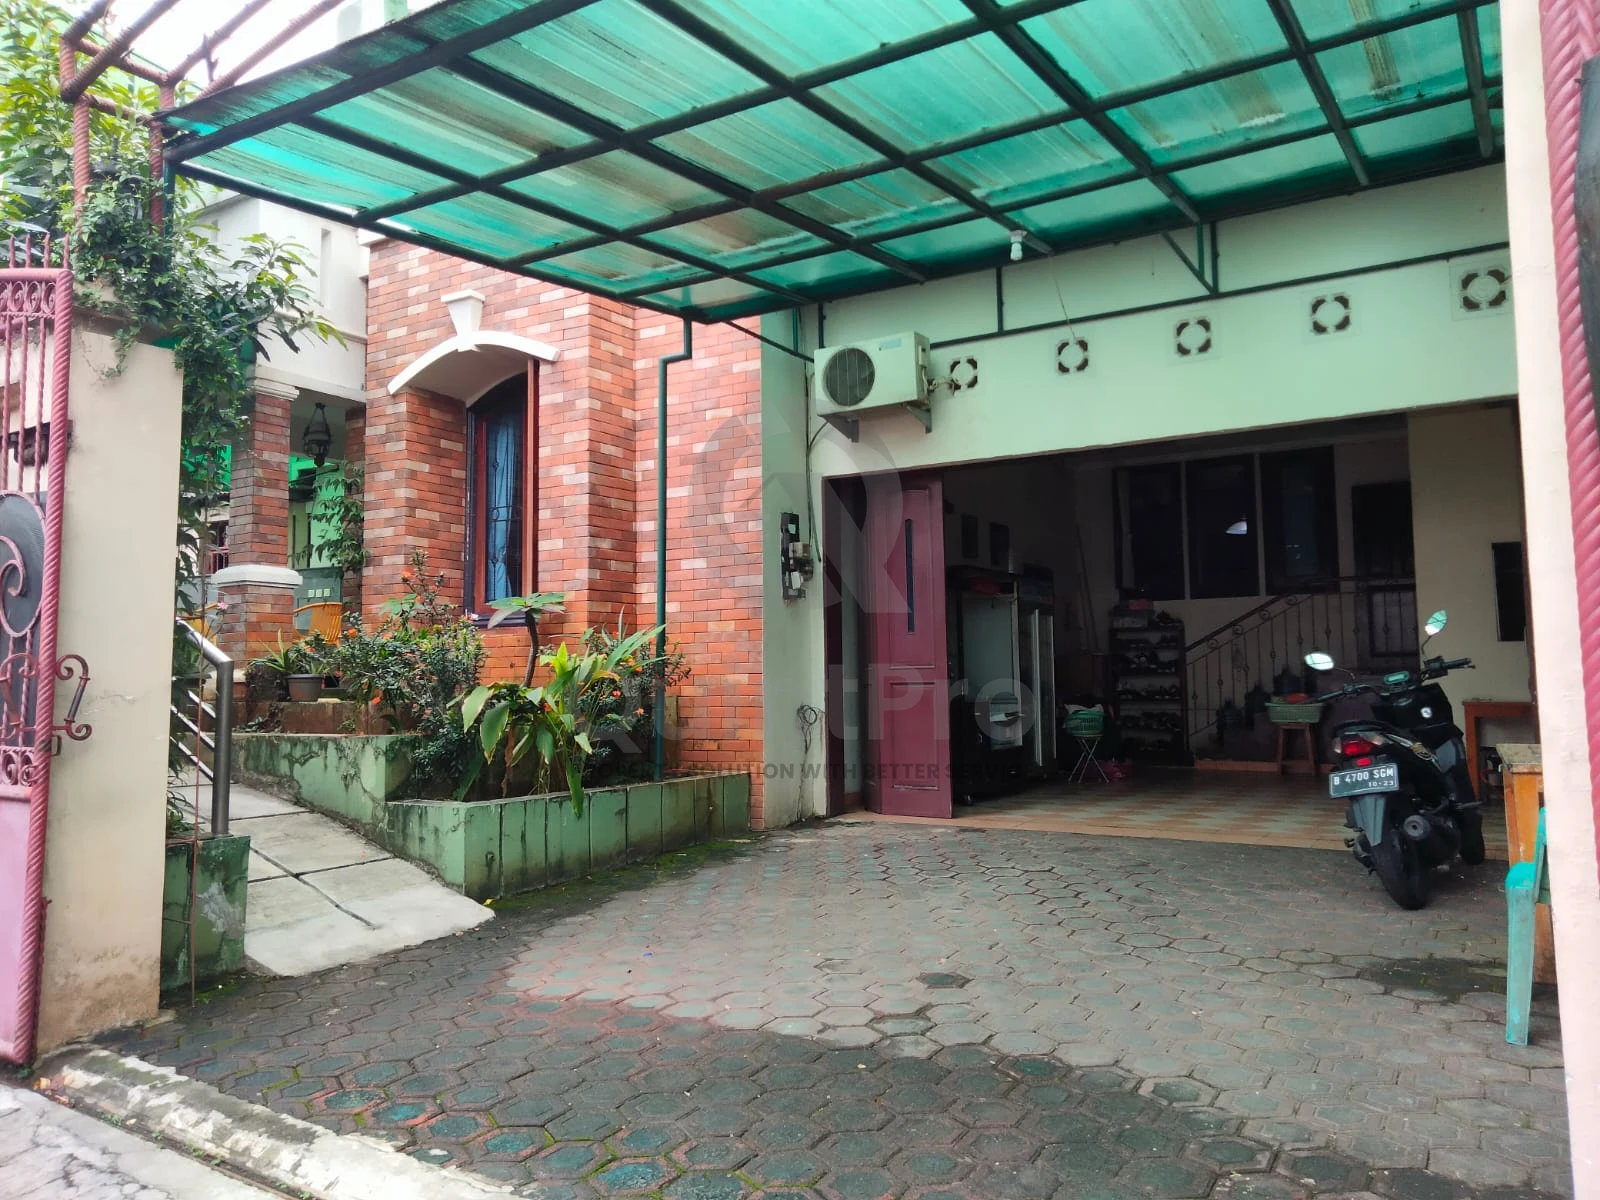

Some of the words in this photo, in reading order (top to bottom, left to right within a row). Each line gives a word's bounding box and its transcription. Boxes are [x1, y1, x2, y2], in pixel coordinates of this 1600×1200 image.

[1333, 776, 1340, 786] B
[1345, 771, 1369, 783] 4700
[1372, 767, 1394, 778] SGM
